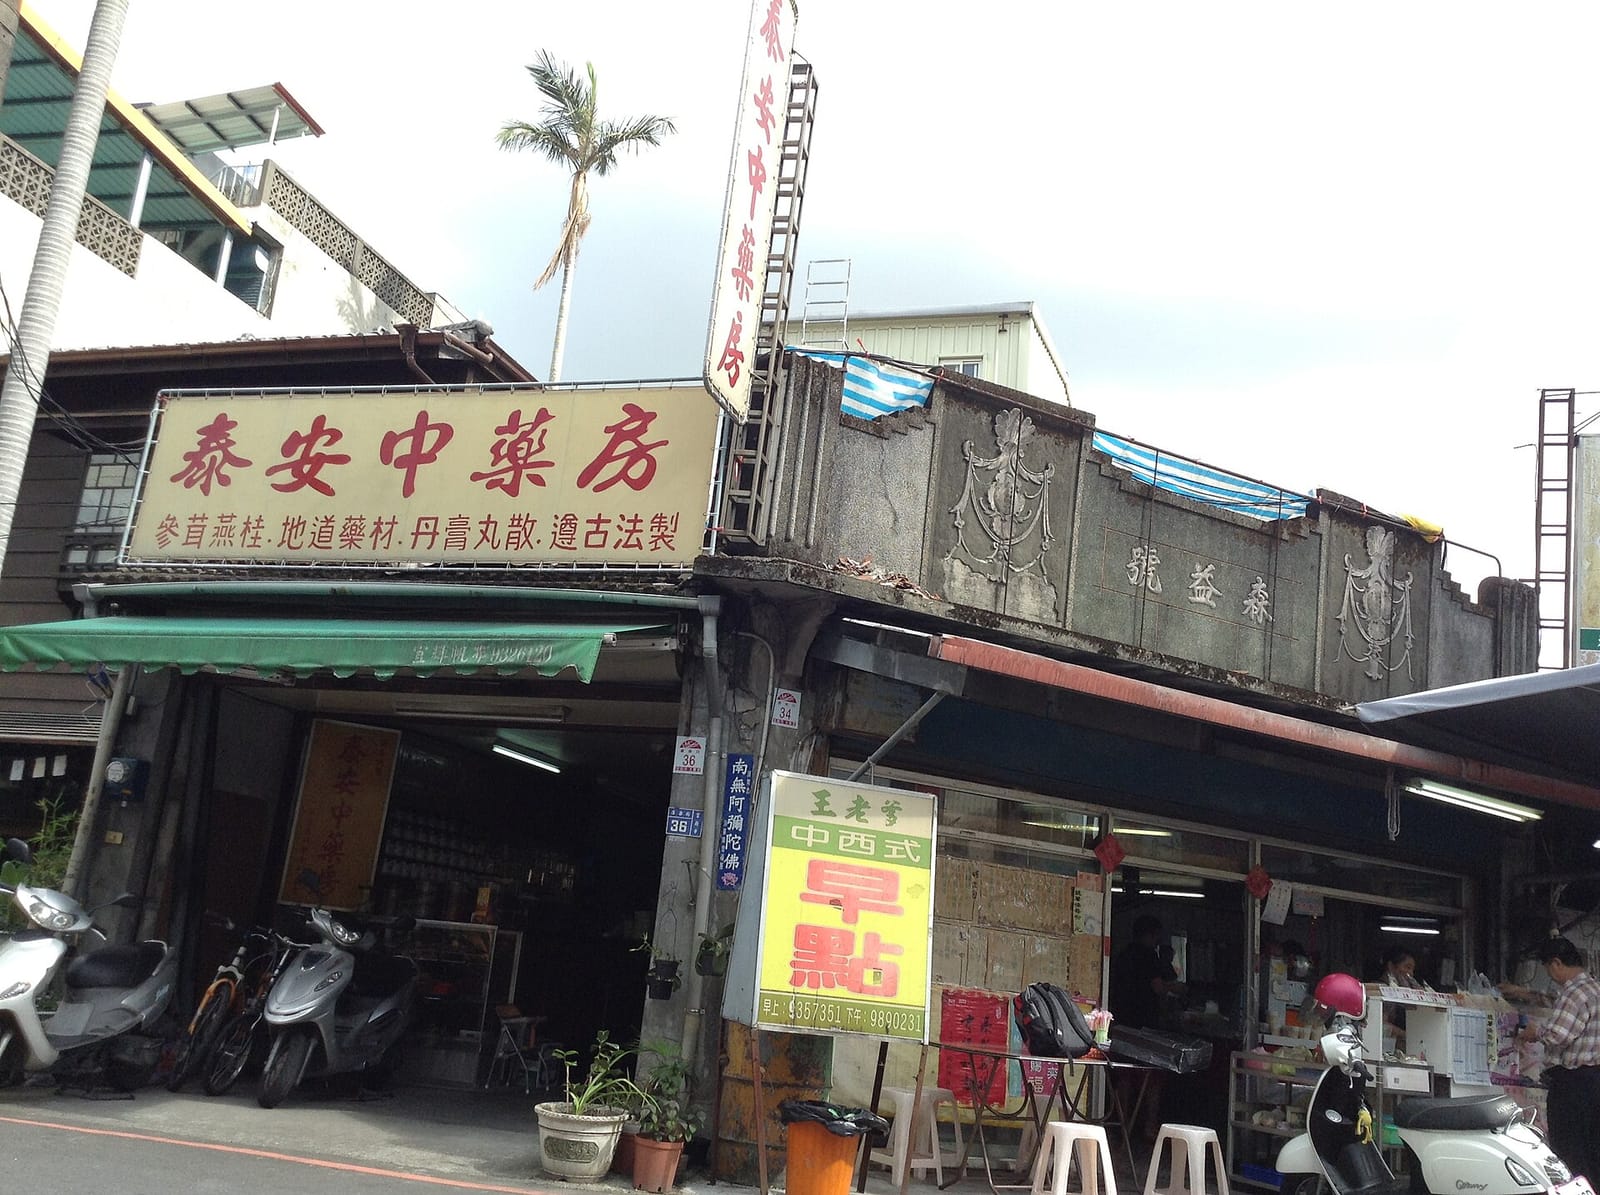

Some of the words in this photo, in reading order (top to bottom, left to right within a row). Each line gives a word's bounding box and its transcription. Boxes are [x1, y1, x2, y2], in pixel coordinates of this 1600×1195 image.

[169, 402, 670, 498] 泰安中藥房
[779, 707, 792, 720] 34
[682, 754, 696, 767] 36
[670, 819, 688, 833] 36
[723, 758, 748, 871] 南無阿彌陀佛
[811, 789, 903, 827] 王老爹
[791, 824, 921, 863] 中西式
[789, 858, 905, 998] 早點
